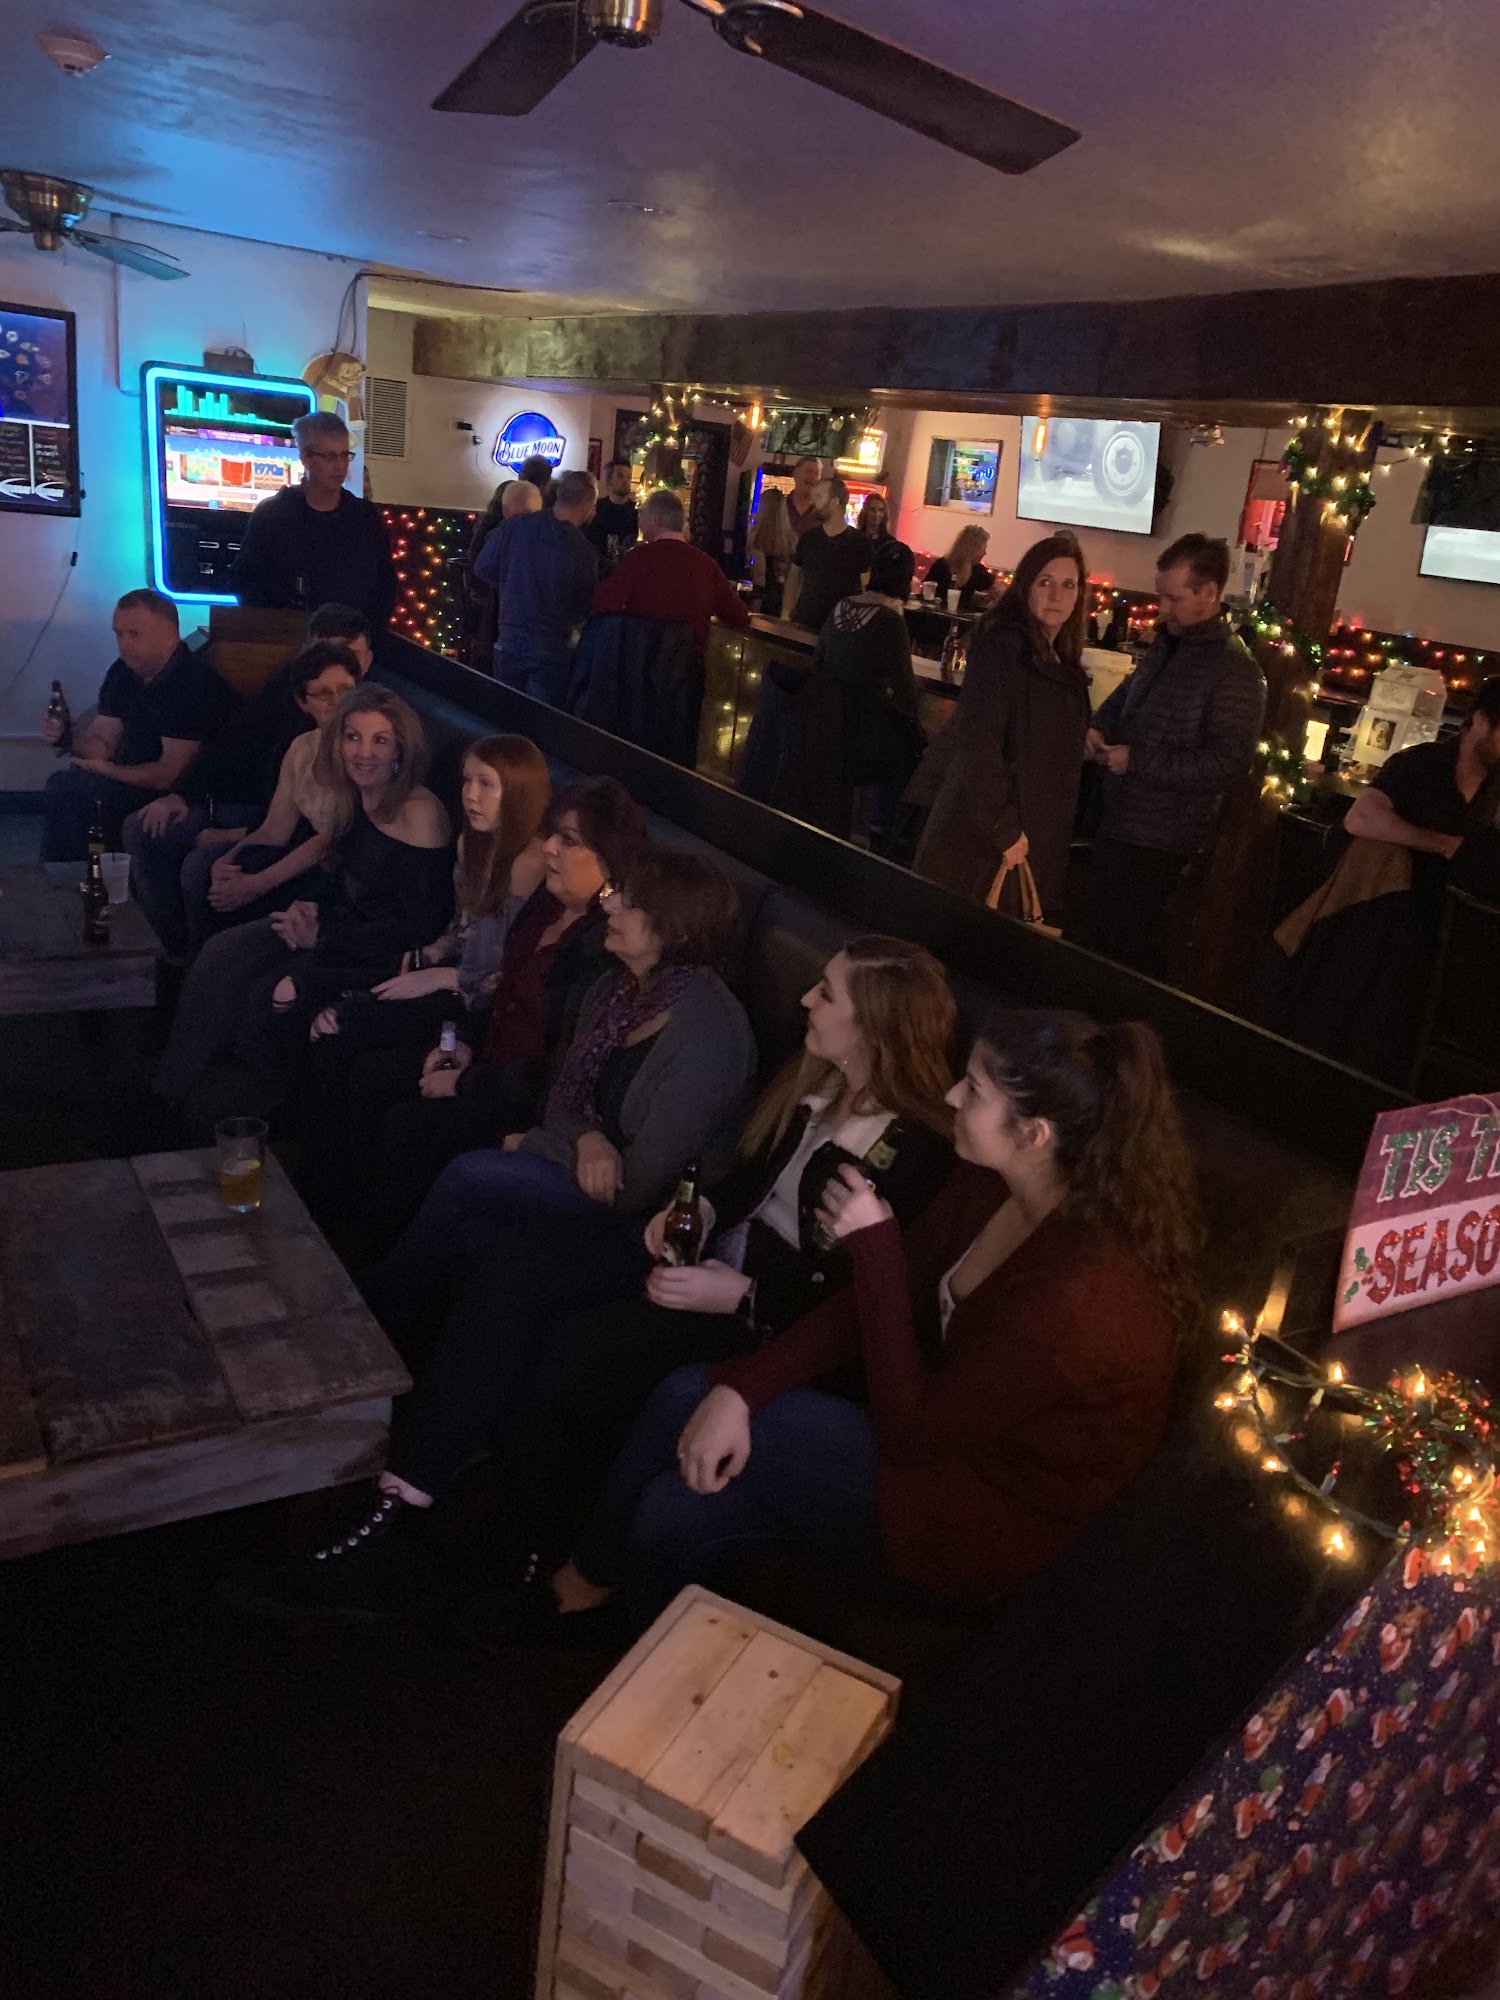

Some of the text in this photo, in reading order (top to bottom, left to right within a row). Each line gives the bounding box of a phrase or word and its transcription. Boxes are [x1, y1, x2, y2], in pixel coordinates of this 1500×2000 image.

[499, 441, 561, 462] BLUE MOON
[1376, 1122, 1460, 1203] TIS
